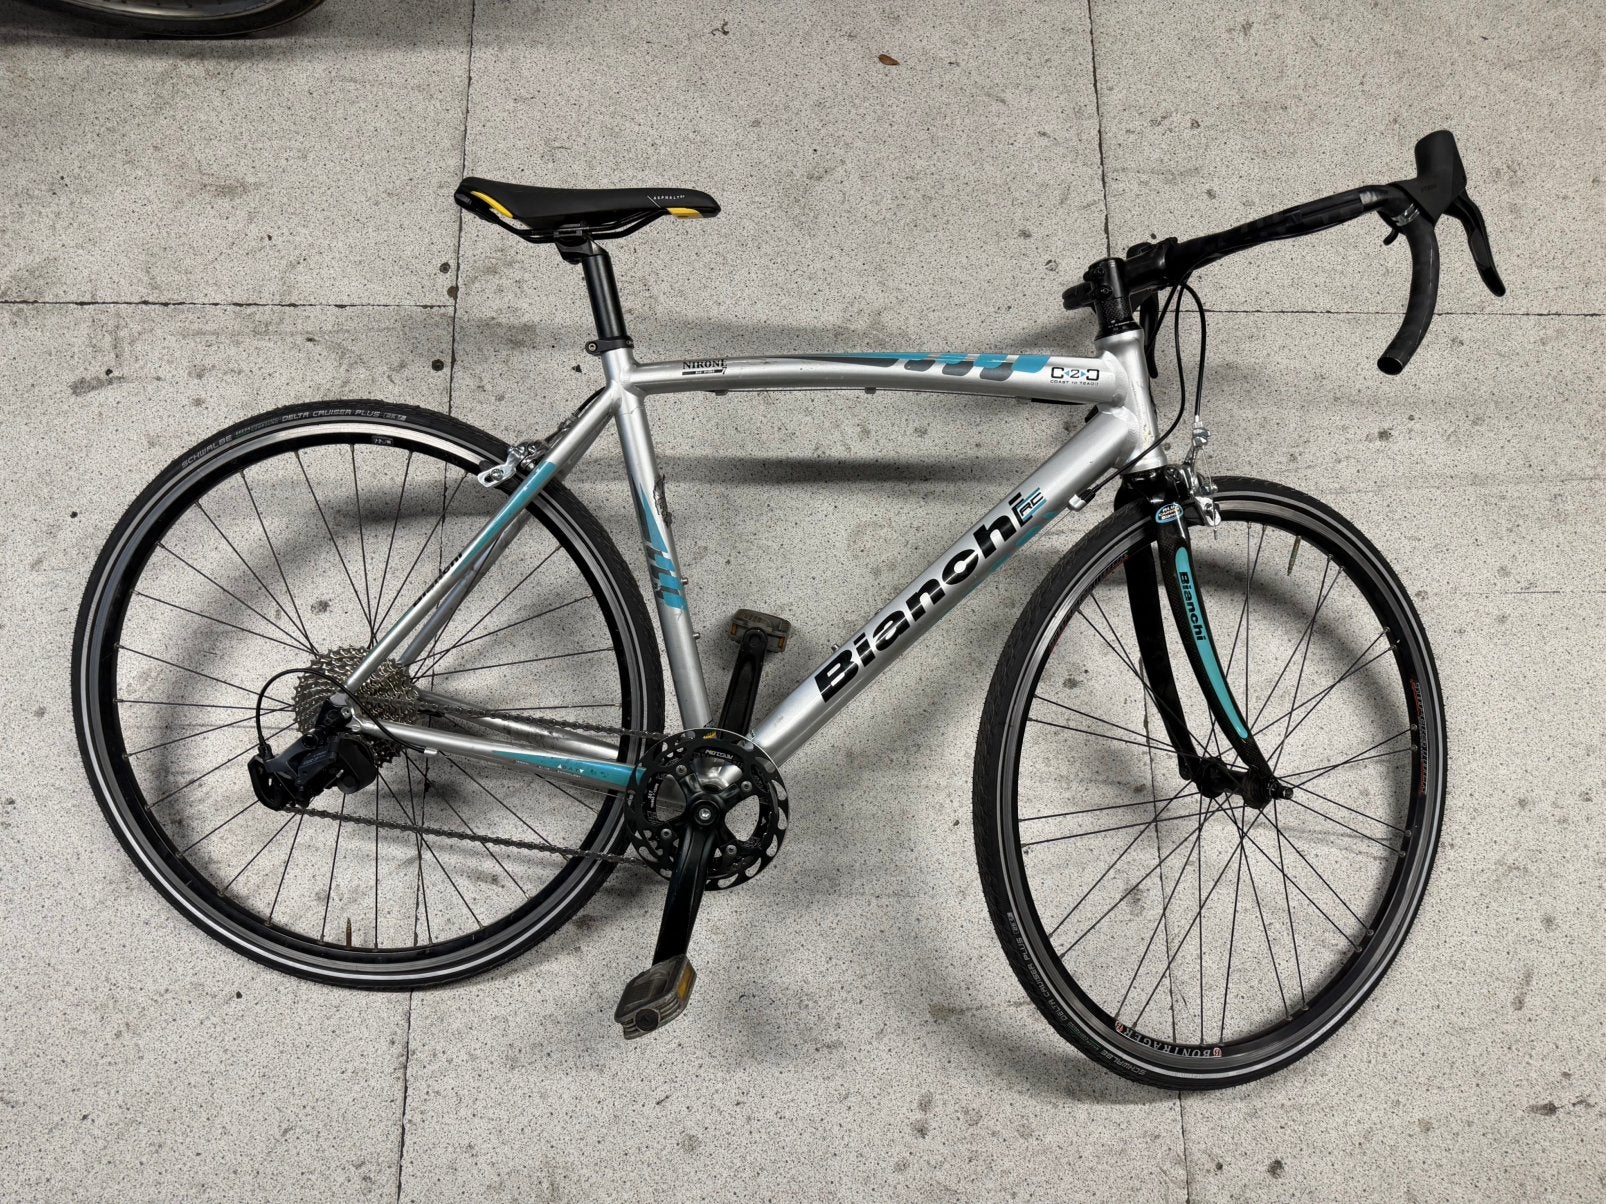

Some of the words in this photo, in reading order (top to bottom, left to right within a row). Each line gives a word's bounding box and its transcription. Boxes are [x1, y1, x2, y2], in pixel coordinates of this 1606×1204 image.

[181, 434, 233, 468] SCHWALBE
[282, 412, 309, 422] DELTA
[312, 408, 352, 417] CRUISER
[354, 409, 381, 418] PLUS
[1020, 491, 1044, 517] RC
[813, 491, 1034, 703] Bianchi
[1179, 571, 1207, 641] Bianchi
[1015, 937, 1031, 961] PLUS
[1123, 1028, 1212, 1058] BONTRAGER
[1100, 1049, 1147, 1076] SCHWALBE
